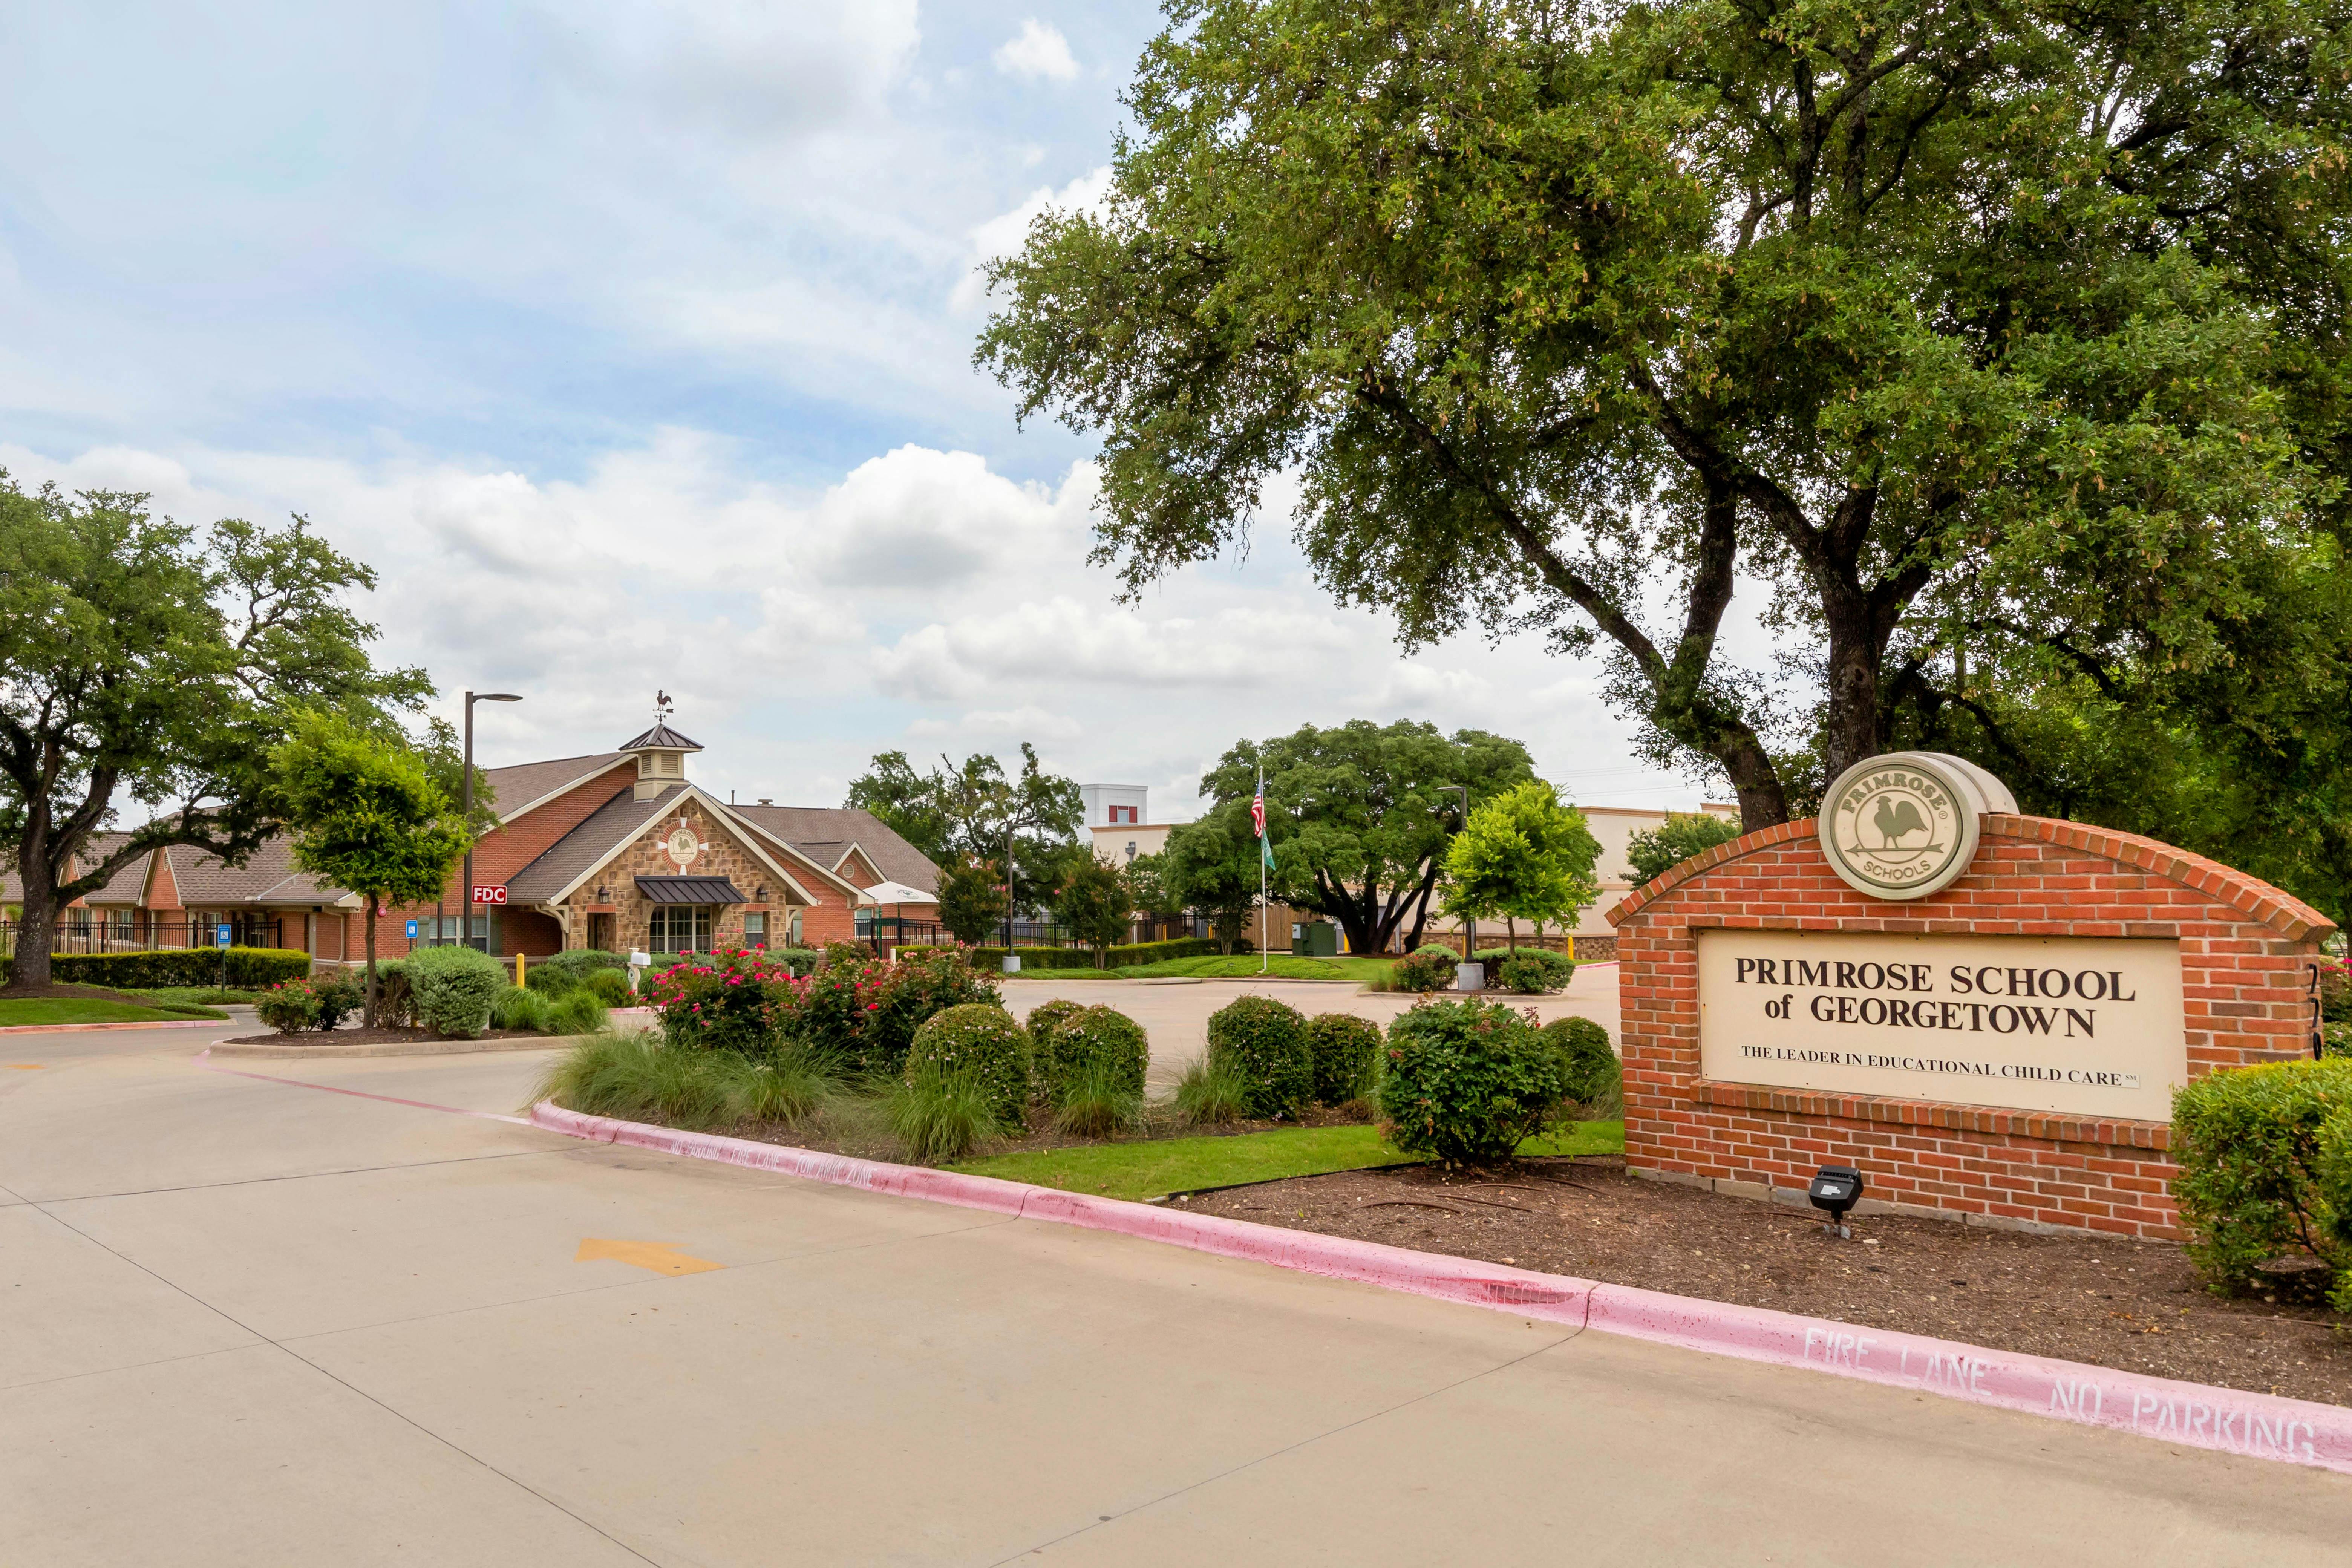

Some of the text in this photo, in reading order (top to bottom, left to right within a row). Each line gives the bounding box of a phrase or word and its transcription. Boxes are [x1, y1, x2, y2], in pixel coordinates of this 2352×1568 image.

[1864, 860, 1931, 880] SCHOOLS
[474, 887, 505, 902] FDC
[1735, 958, 2136, 1001] PRIMROSE SCHOOL
[1765, 994, 2097, 1038] of GEORGETOWN
[1741, 1045, 1772, 1058] THE
[1777, 1048, 1841, 1064] LEADER
[1846, 1053, 1862, 1065] IN
[1868, 1055, 1996, 1076] EDUCATIONAL
[2001, 1065, 2061, 1081] CHILD
[2068, 1070, 2122, 1086] CARE
[669, 1139, 683, 1155] NO
[686, 1141, 720, 1160] PARKING
[730, 1147, 749, 1166] FIRE
[756, 1149, 783, 1170] LANE
[794, 1155, 817, 1175] TOW
[845, 1167, 877, 1187] ZONE
[1804, 1327, 2314, 1461] FIRE LANE NO PARKING
